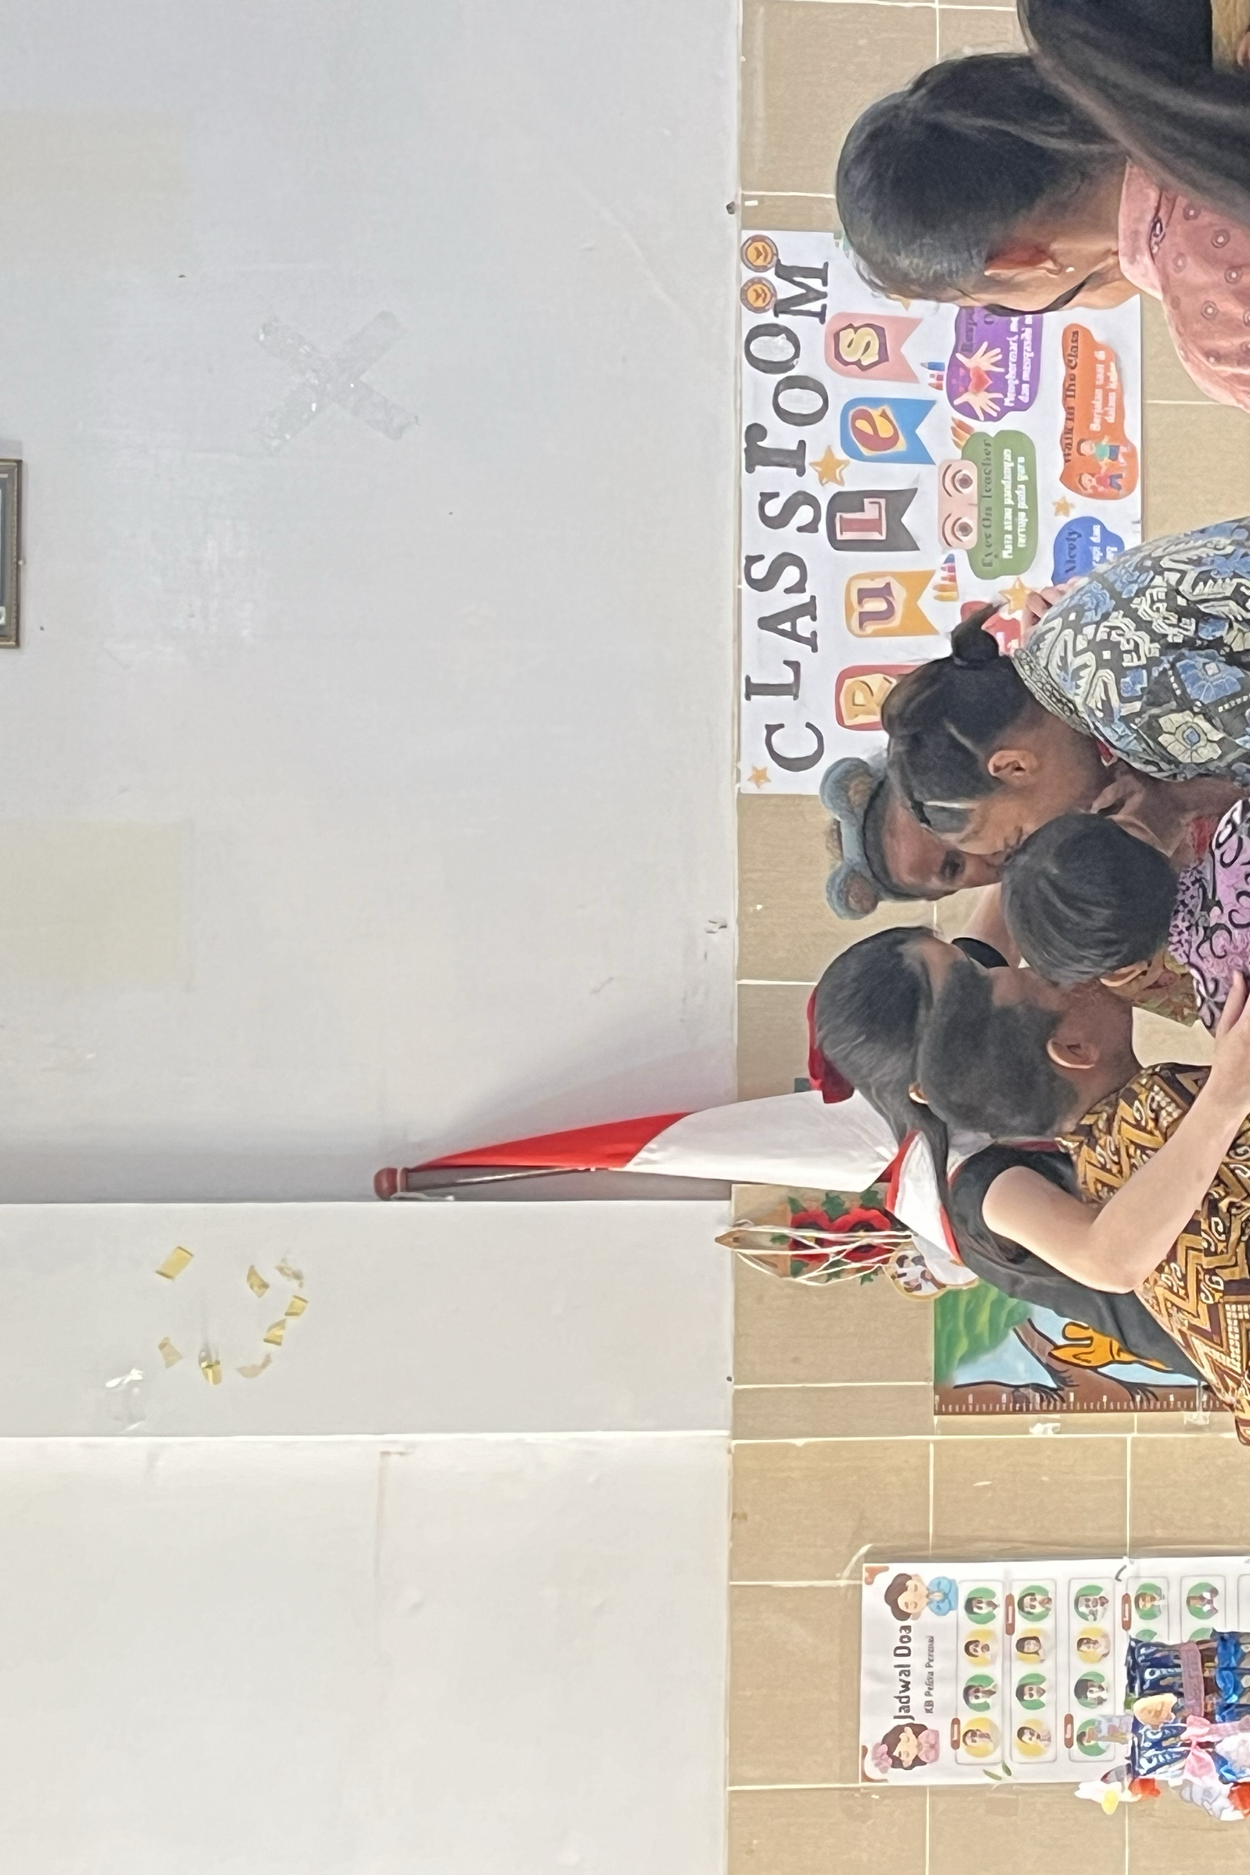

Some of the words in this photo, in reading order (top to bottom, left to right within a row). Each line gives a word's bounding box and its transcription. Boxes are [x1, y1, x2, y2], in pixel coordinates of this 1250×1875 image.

[1066, 330, 1079, 370] Class
[1094, 350, 1106, 360] di
[1018, 383, 1030, 403] dan
[1064, 373, 1076, 399] The
[1064, 405, 1075, 422] In
[1089, 388, 1104, 431] Berjalan
[1103, 391, 1117, 423] dalam
[1063, 425, 1075, 463] Walk
[981, 439, 993, 499] Teacher
[1001, 448, 1014, 505] pandangan
[1016, 456, 1029, 481] guru
[1015, 484, 1028, 509] pada
[982, 506, 993, 529] On
[1003, 507, 1013, 531] atau
[1089, 524, 1101, 543] dan
[981, 533, 998, 567] Eyes
[1002, 534, 1013, 559] Mata
[893, 1625, 912, 1658] Doa
[893, 1664, 915, 1721] Jadwal
[924, 1700, 934, 1714] KB
